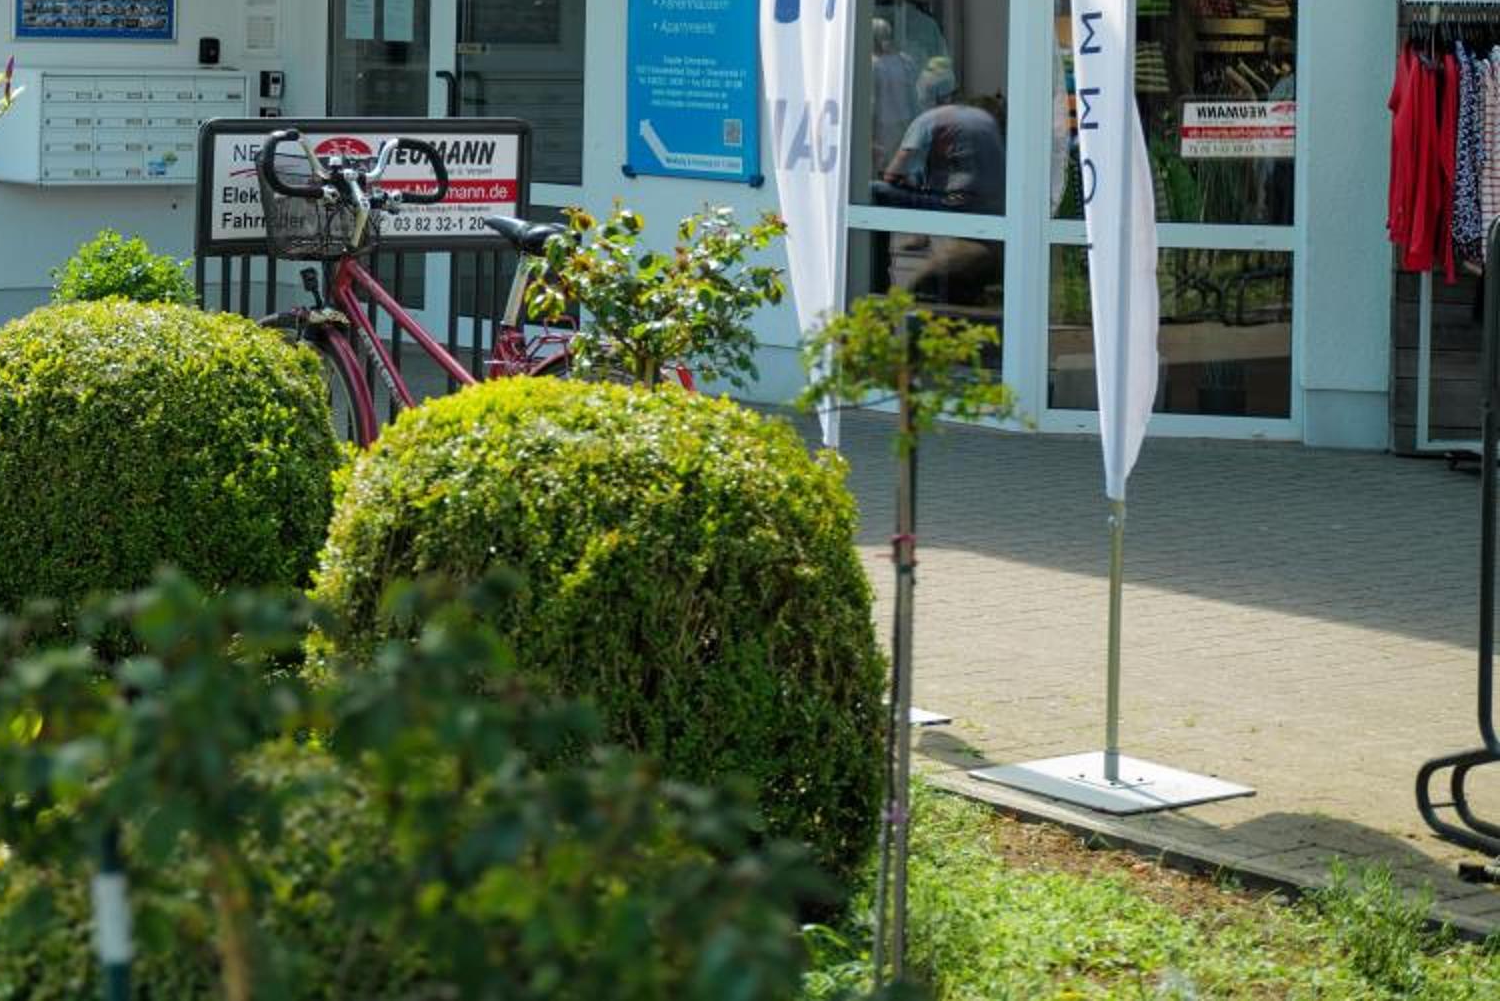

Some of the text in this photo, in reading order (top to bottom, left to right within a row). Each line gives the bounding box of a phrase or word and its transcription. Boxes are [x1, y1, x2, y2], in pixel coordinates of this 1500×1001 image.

[393, 216, 411, 231] 03
[415, 216, 431, 231] 82
[435, 216, 464, 231] 32-1
